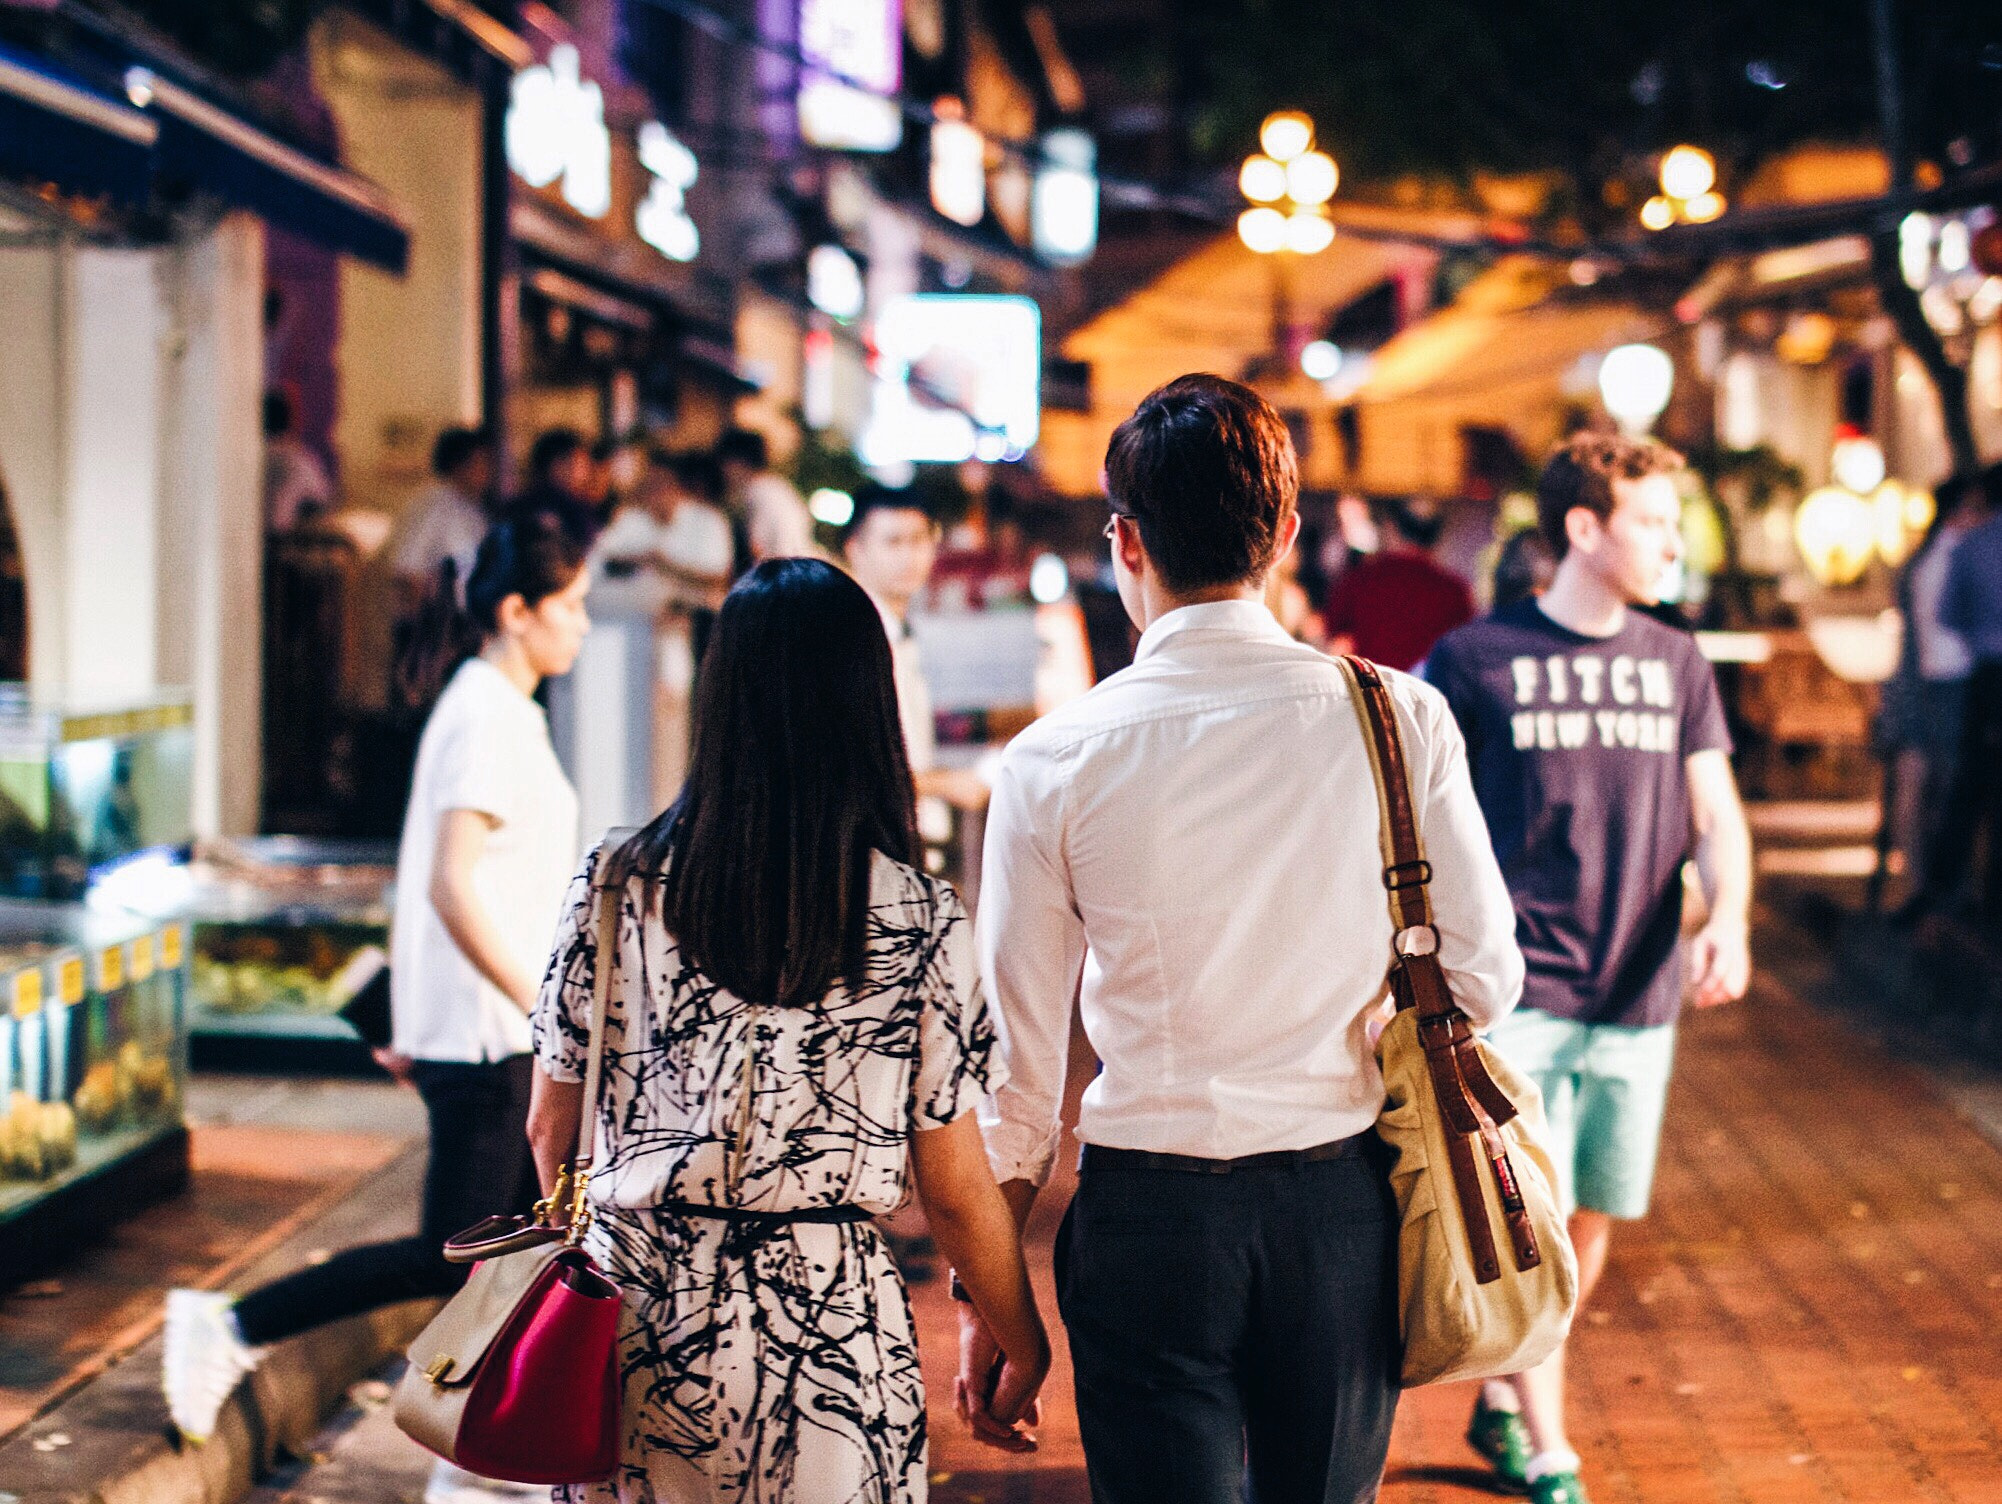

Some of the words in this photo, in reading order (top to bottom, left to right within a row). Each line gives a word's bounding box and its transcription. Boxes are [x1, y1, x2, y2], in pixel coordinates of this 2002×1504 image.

[1511, 654, 1673, 708] FITCH
[1510, 710, 1590, 751] NEW
[1595, 709, 1677, 752] YORK
